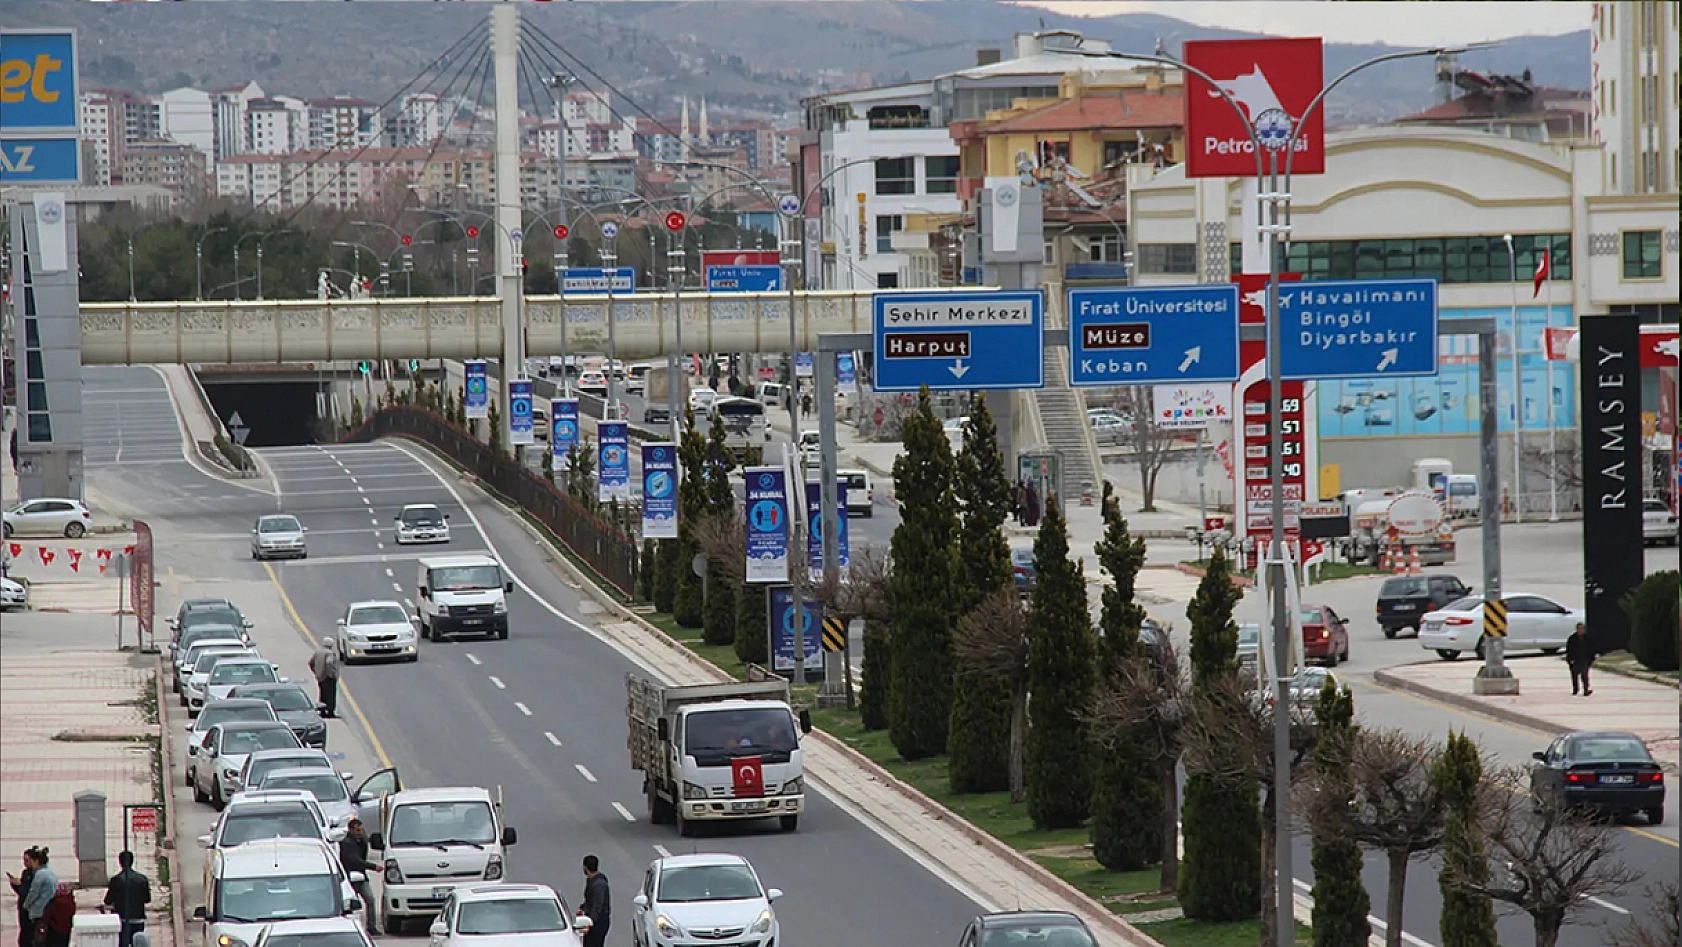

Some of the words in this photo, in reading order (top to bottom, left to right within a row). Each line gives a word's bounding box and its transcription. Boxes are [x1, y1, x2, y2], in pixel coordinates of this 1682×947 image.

[1205, 137, 1255, 154] Petro
[1301, 289, 1425, 305] Havalimanı
[889, 307, 939, 323] Şehir
[948, 306, 1027, 321] Merkezi
[1080, 301, 1120, 316] Fırat
[1126, 297, 1228, 314] Üniversitesi
[1300, 309, 1371, 328] Bingöl
[1087, 329, 1145, 345] Müze
[1300, 329, 1418, 350] Diyarbakır
[889, 338, 967, 356] Harput
[1080, 358, 1148, 374] Keban
[1280, 398, 1300, 413] .69
[1280, 420, 1300, 434] .57
[1598, 345, 1627, 509] RAMSEY
[1281, 442, 1301, 456] .61
[1281, 463, 1302, 477] .40
[1248, 485, 1300, 500] Maet
